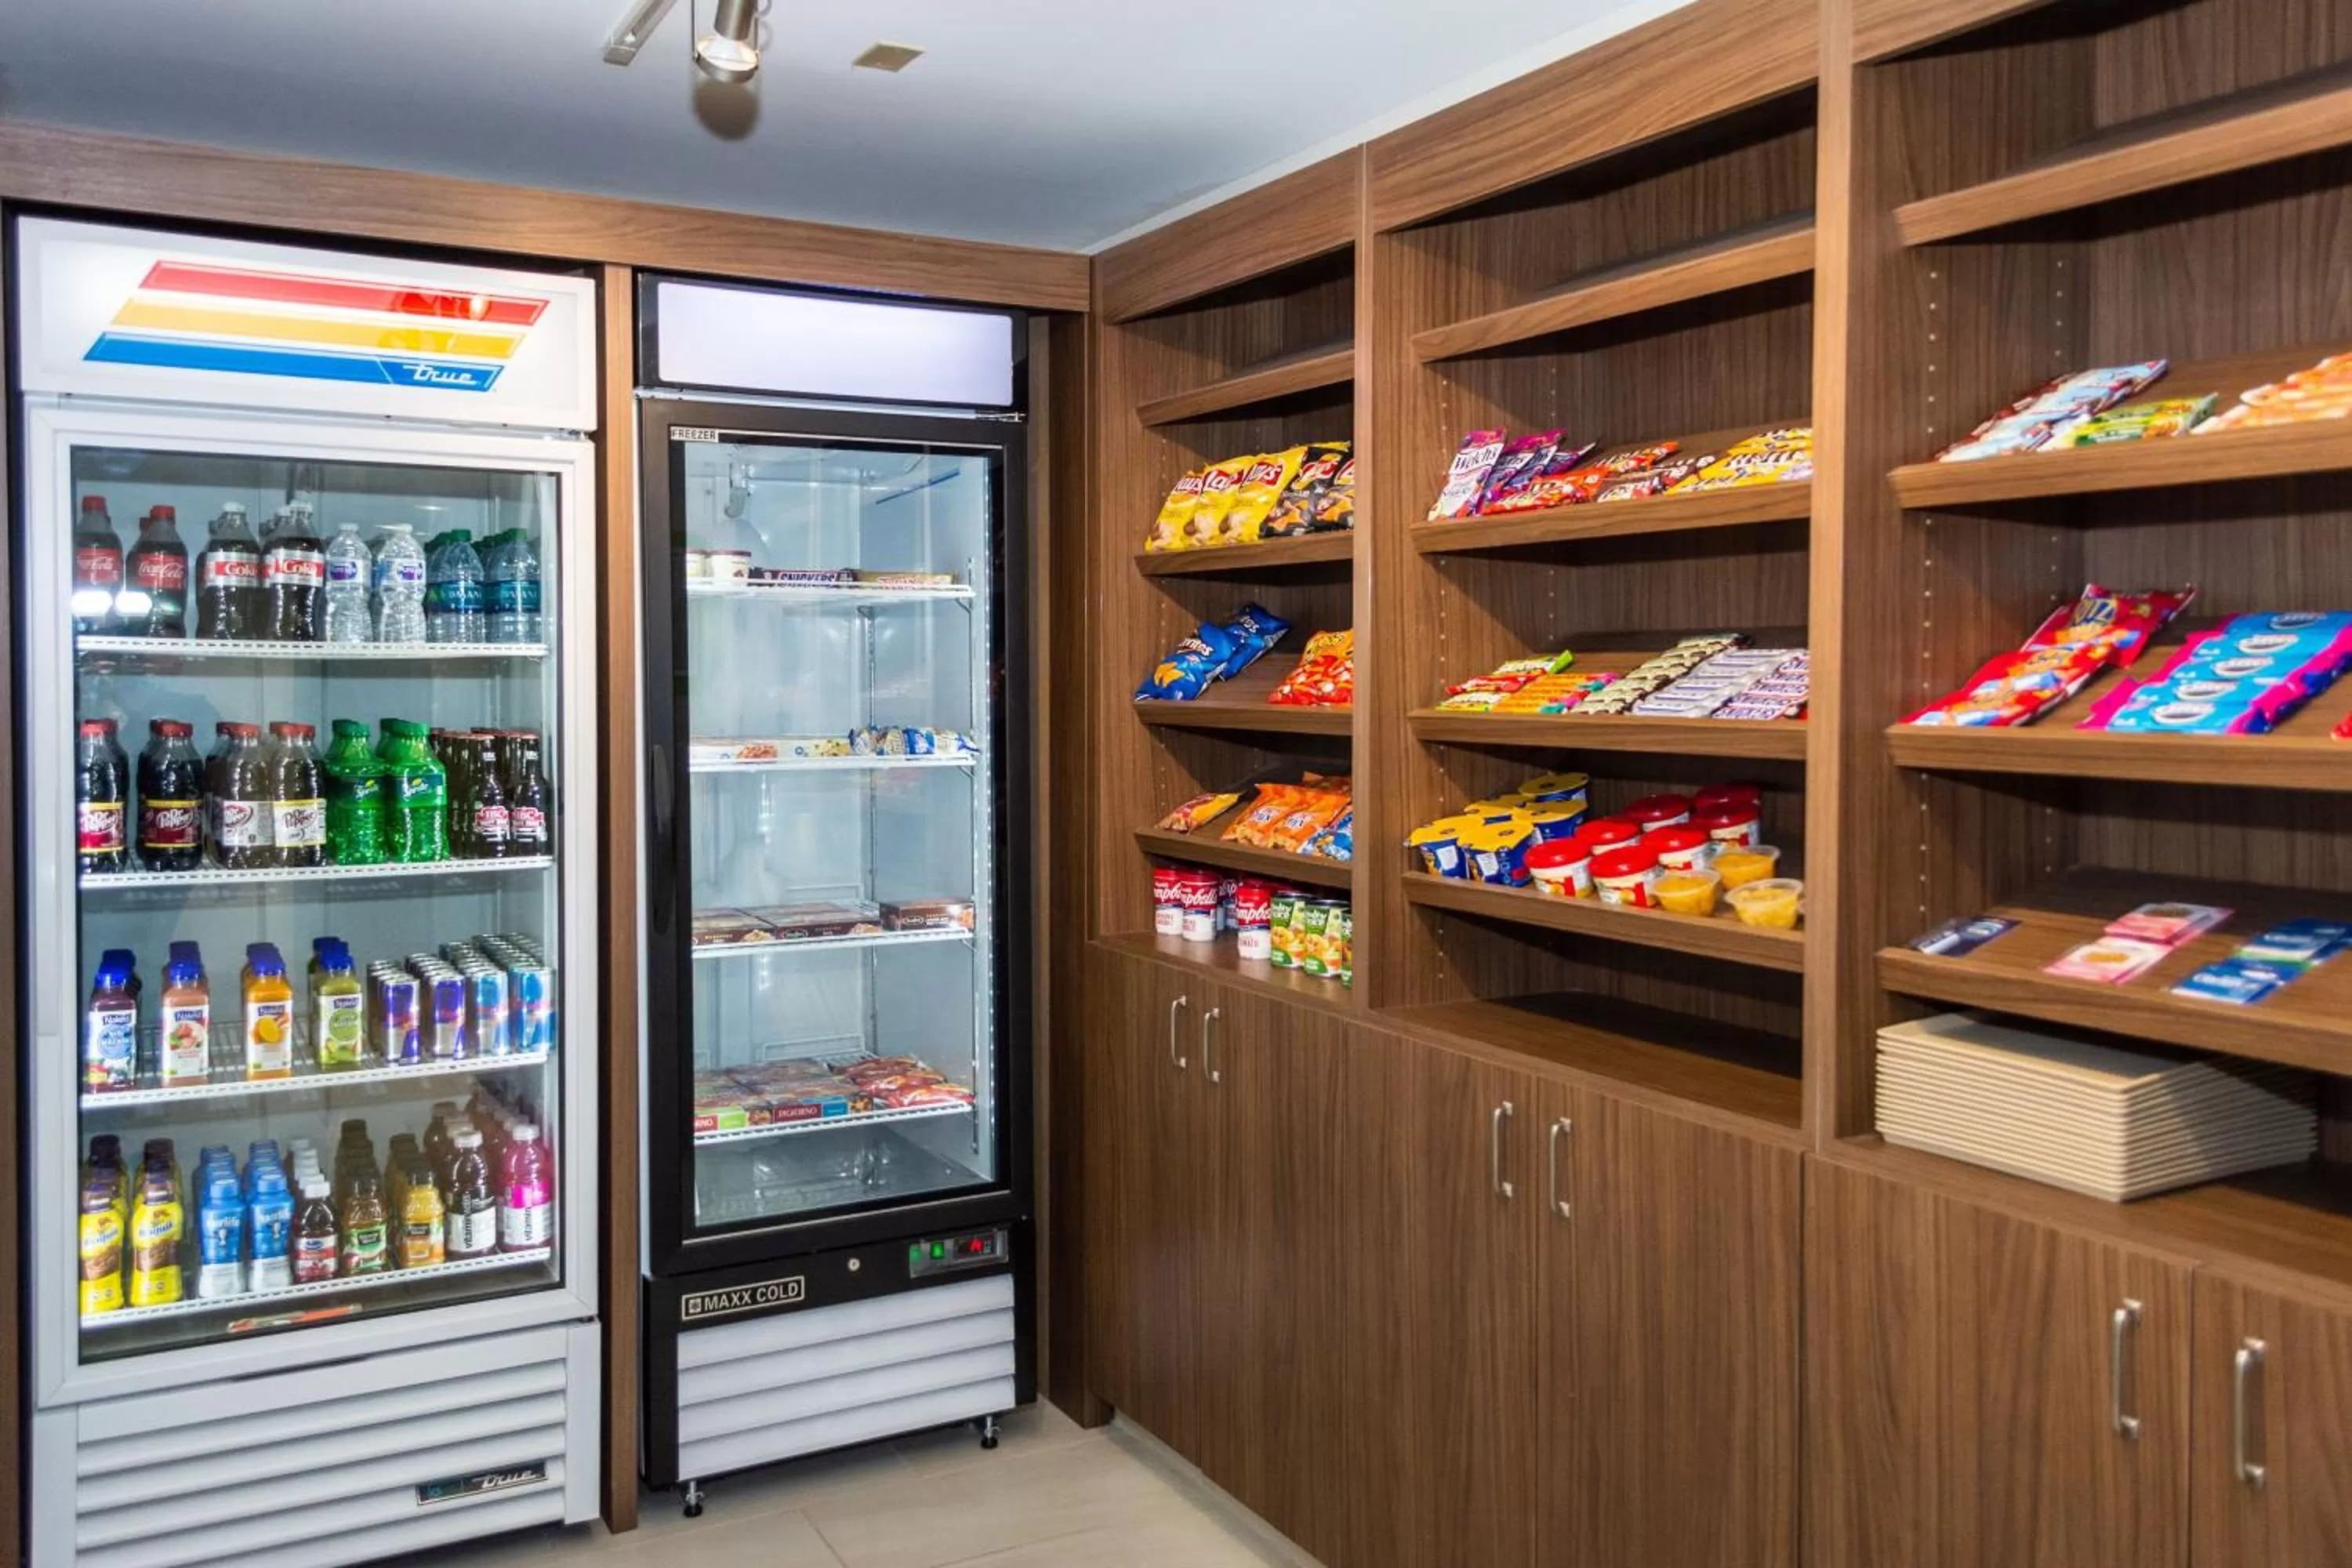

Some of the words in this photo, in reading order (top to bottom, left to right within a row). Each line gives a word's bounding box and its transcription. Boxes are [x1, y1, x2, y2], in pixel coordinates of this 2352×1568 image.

[672, 429, 716, 440] FREEZER
[705, 1288, 752, 1312] MAXX
[757, 1282, 798, 1304] COLD
